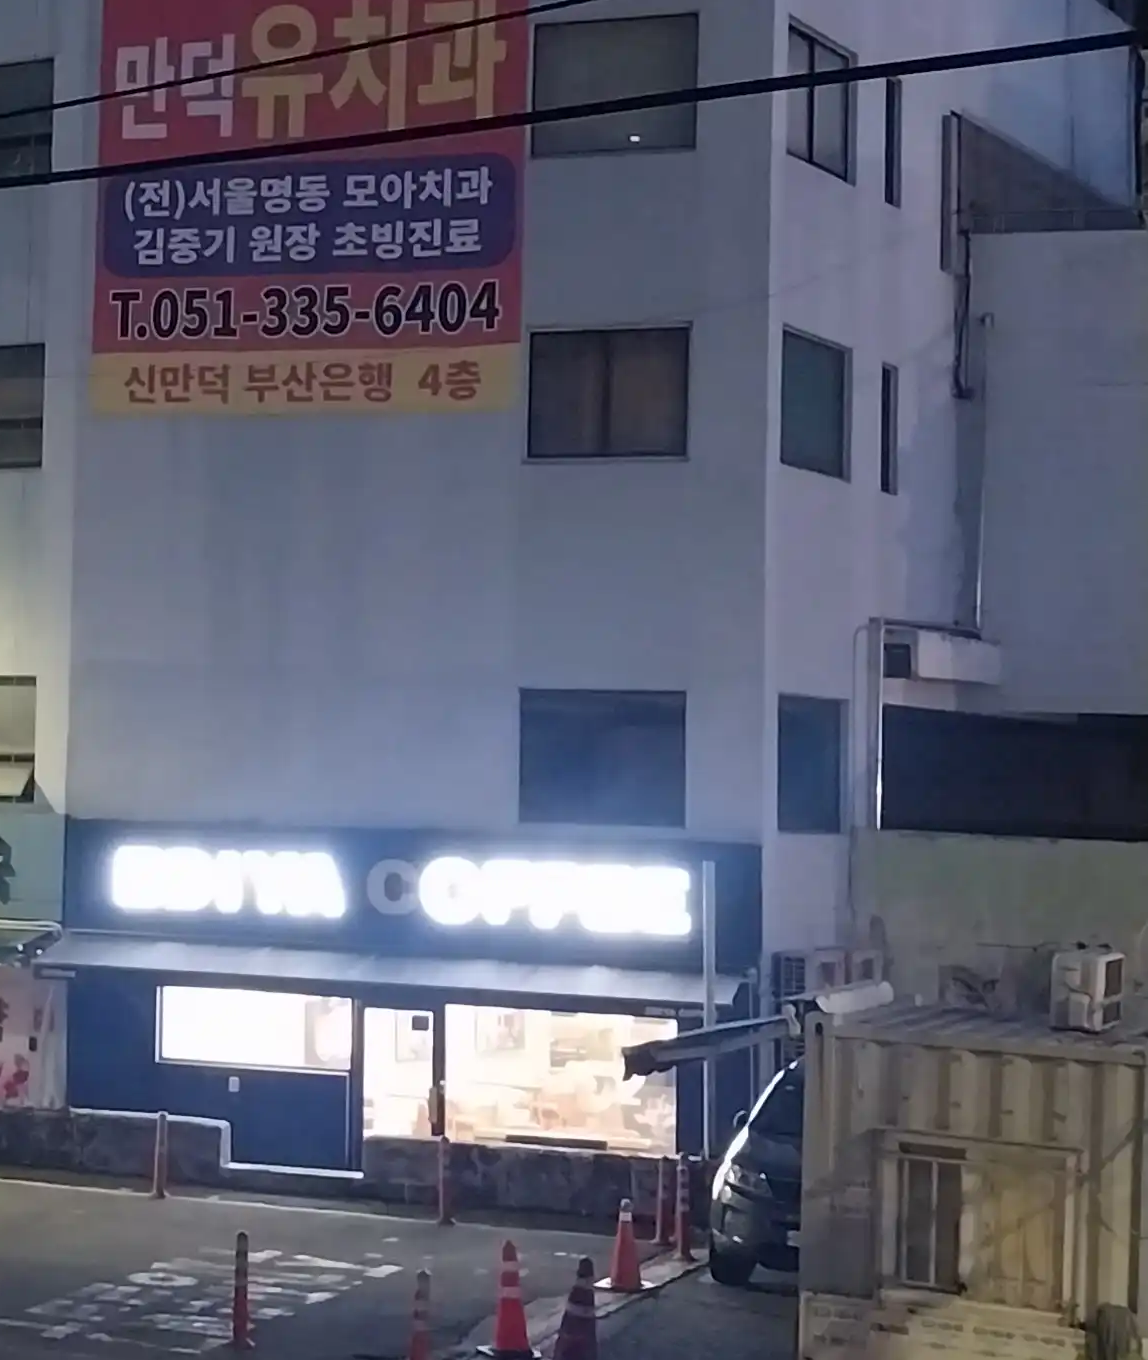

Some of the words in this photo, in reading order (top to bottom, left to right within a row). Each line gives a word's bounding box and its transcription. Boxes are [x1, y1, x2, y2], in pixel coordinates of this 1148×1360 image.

[124, 169, 331, 221] (전)서울명동
[342, 166, 493, 213] 모아치과
[133, 225, 237, 266] 김중기
[249, 222, 321, 262] 원장
[332, 219, 483, 260] 초빙진료
[110, 278, 502, 340] T.051-335-6404
[124, 363, 230, 404] 신만덕
[244, 359, 393, 405] 부산은행
[418, 359, 483, 400] 4층
